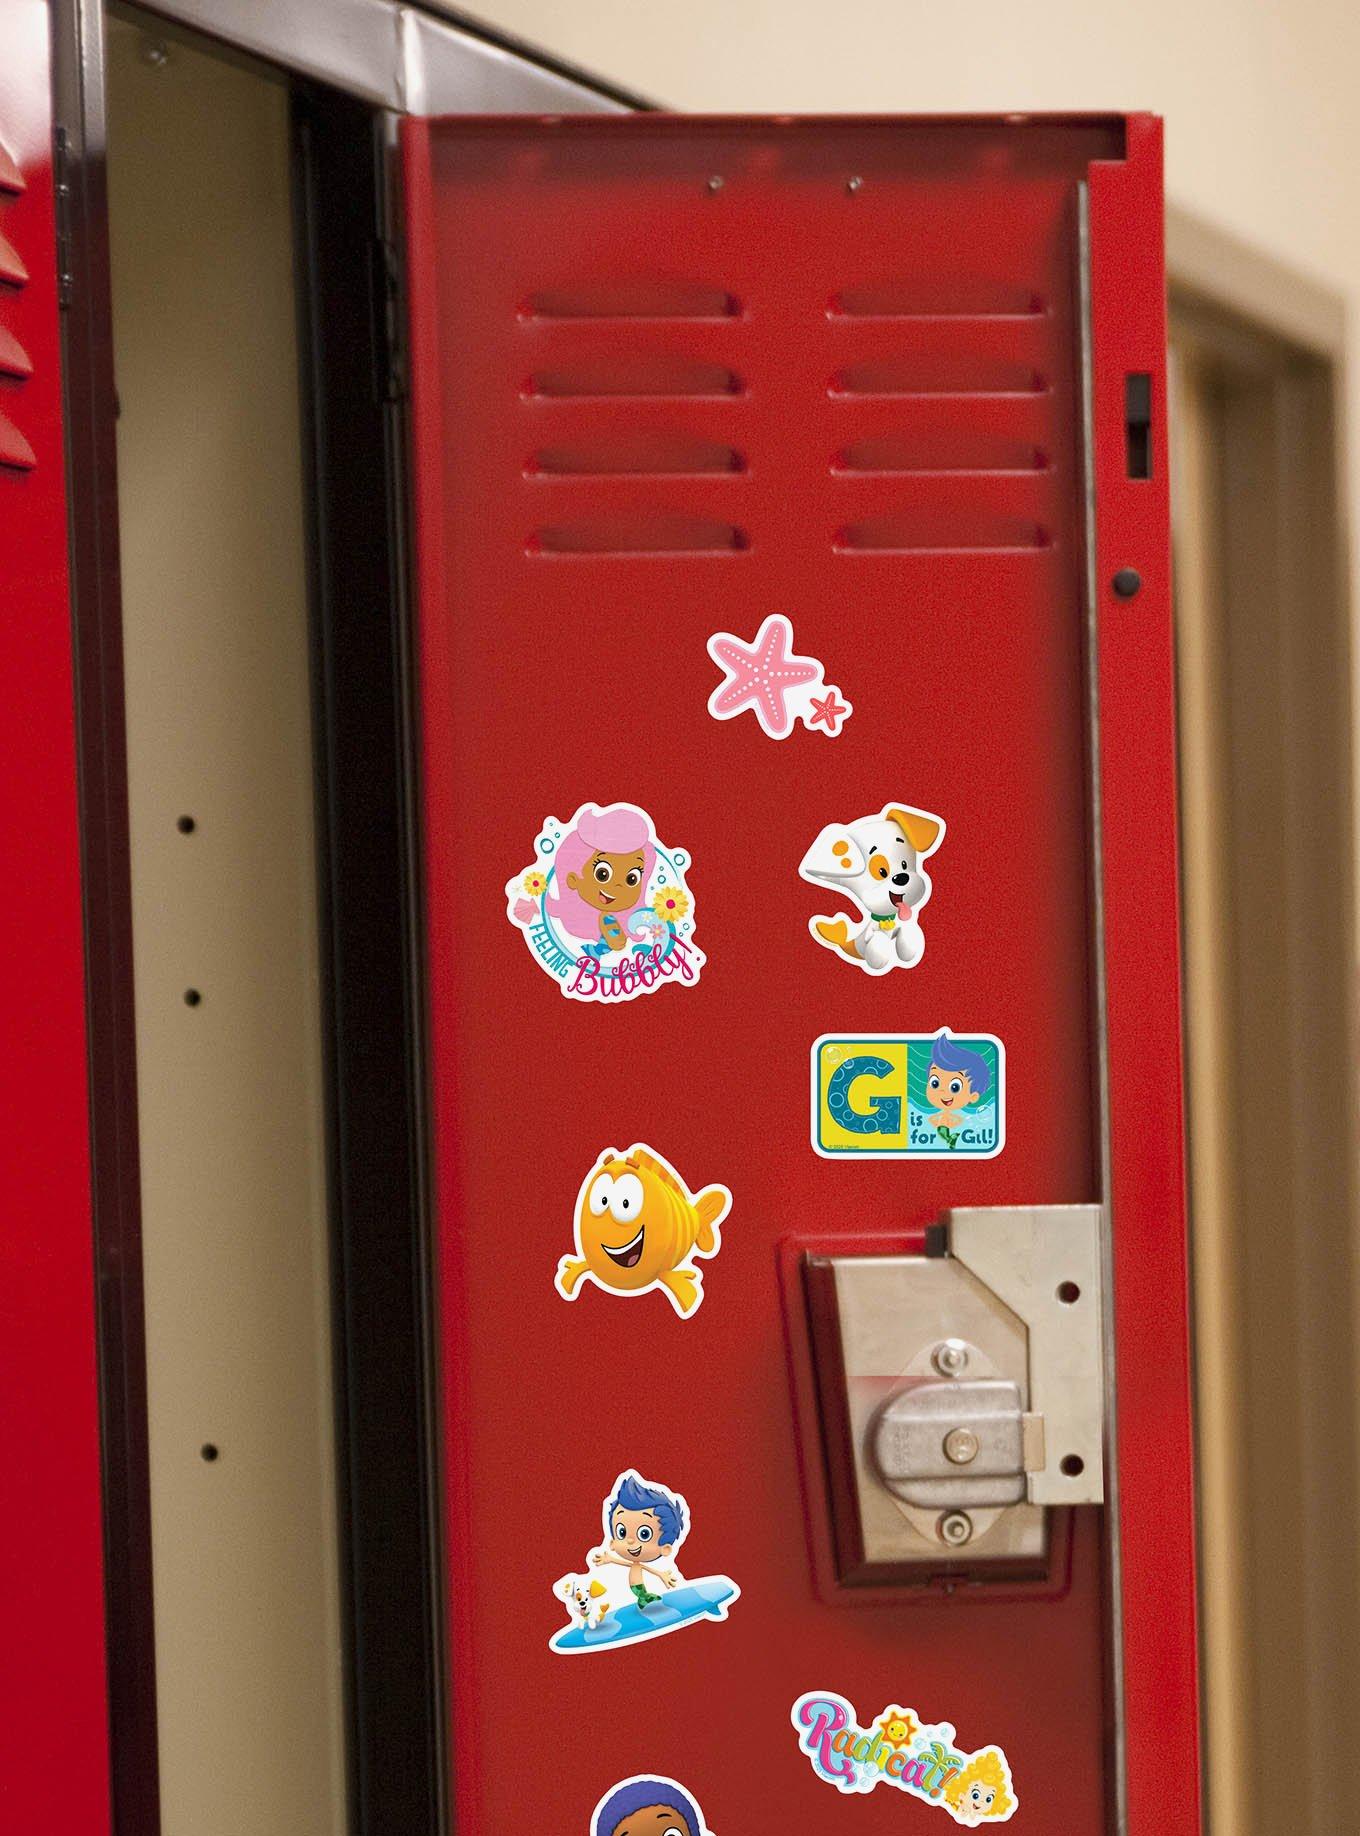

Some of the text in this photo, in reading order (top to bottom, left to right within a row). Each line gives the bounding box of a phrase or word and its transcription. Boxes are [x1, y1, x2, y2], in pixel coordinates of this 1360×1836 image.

[529, 922, 570, 978] FEELING
[567, 932, 701, 997] Bubbly!
[827, 1055, 902, 1134] G
[911, 1112, 923, 1127] is
[910, 1129, 993, 1145] for Gil!
[799, 1698, 959, 1798] Radical!
